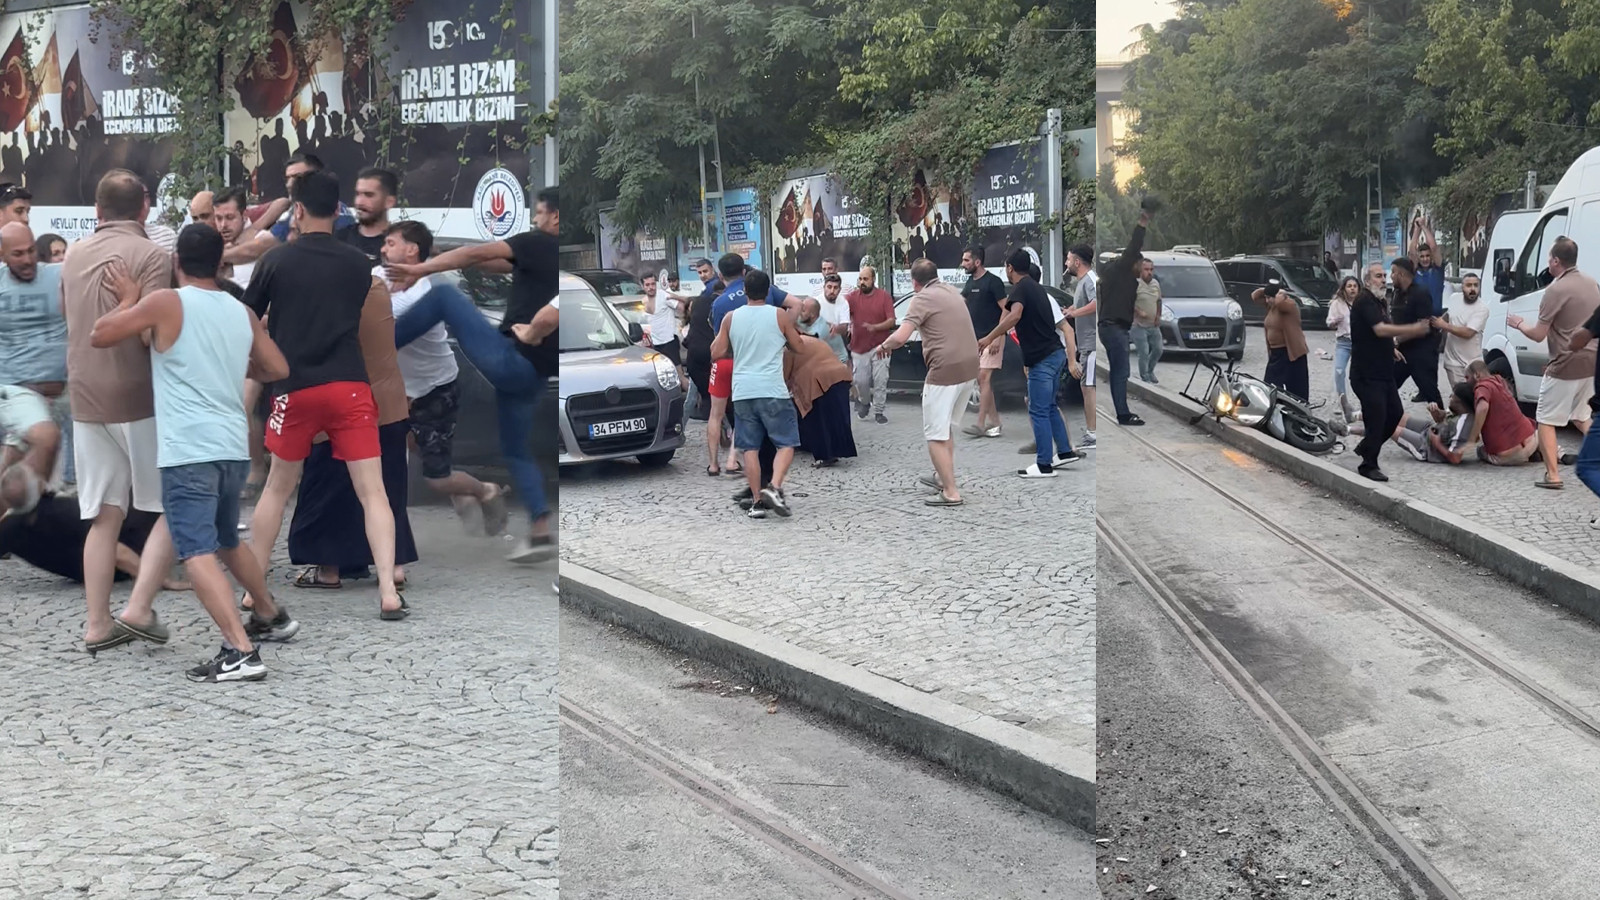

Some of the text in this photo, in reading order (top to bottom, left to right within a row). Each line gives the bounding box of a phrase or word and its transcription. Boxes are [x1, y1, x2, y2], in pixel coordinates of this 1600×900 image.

[401, 65, 456, 100] İRADE
[593, 418, 646, 435] 34 PFM 90
